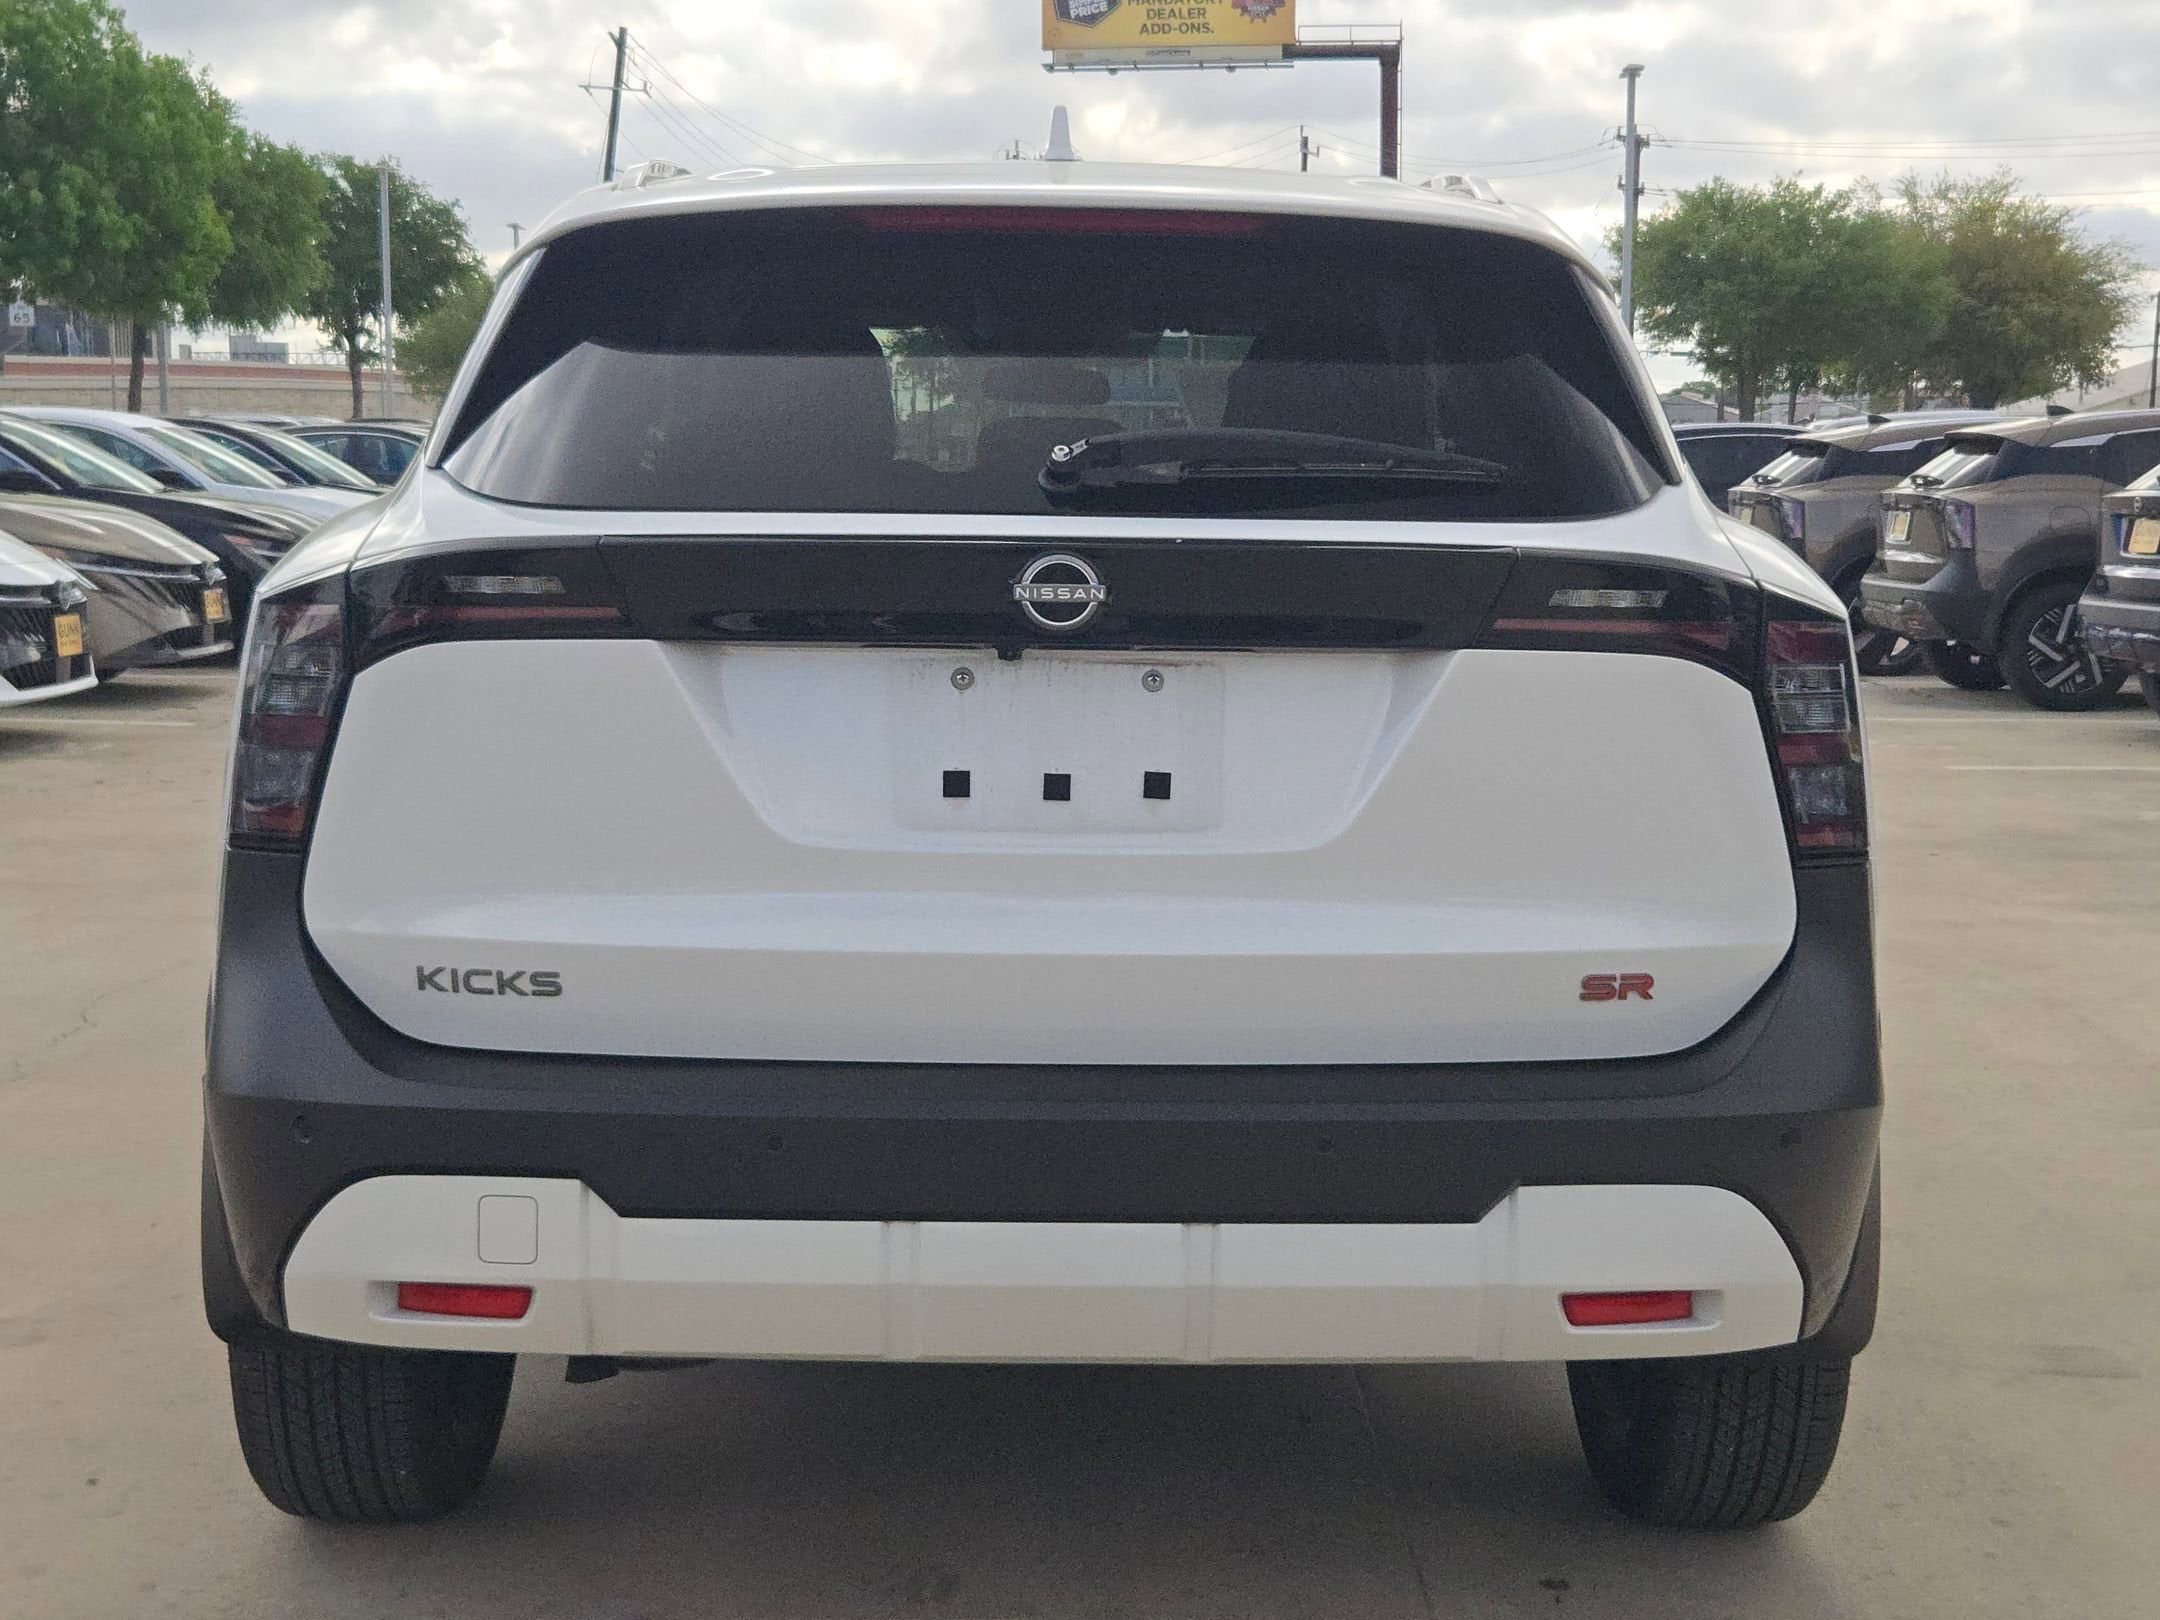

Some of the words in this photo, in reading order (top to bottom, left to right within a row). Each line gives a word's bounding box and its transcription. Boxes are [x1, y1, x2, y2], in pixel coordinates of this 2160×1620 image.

[1070, 1, 1108, 19] PRICE
[1146, 8, 1207, 20] DEALER
[1140, 22, 1215, 35] ADD-ONS.
[1015, 587, 1104, 599] NISSAN
[416, 965, 563, 997] KICKS
[1579, 973, 1655, 1001] SR
